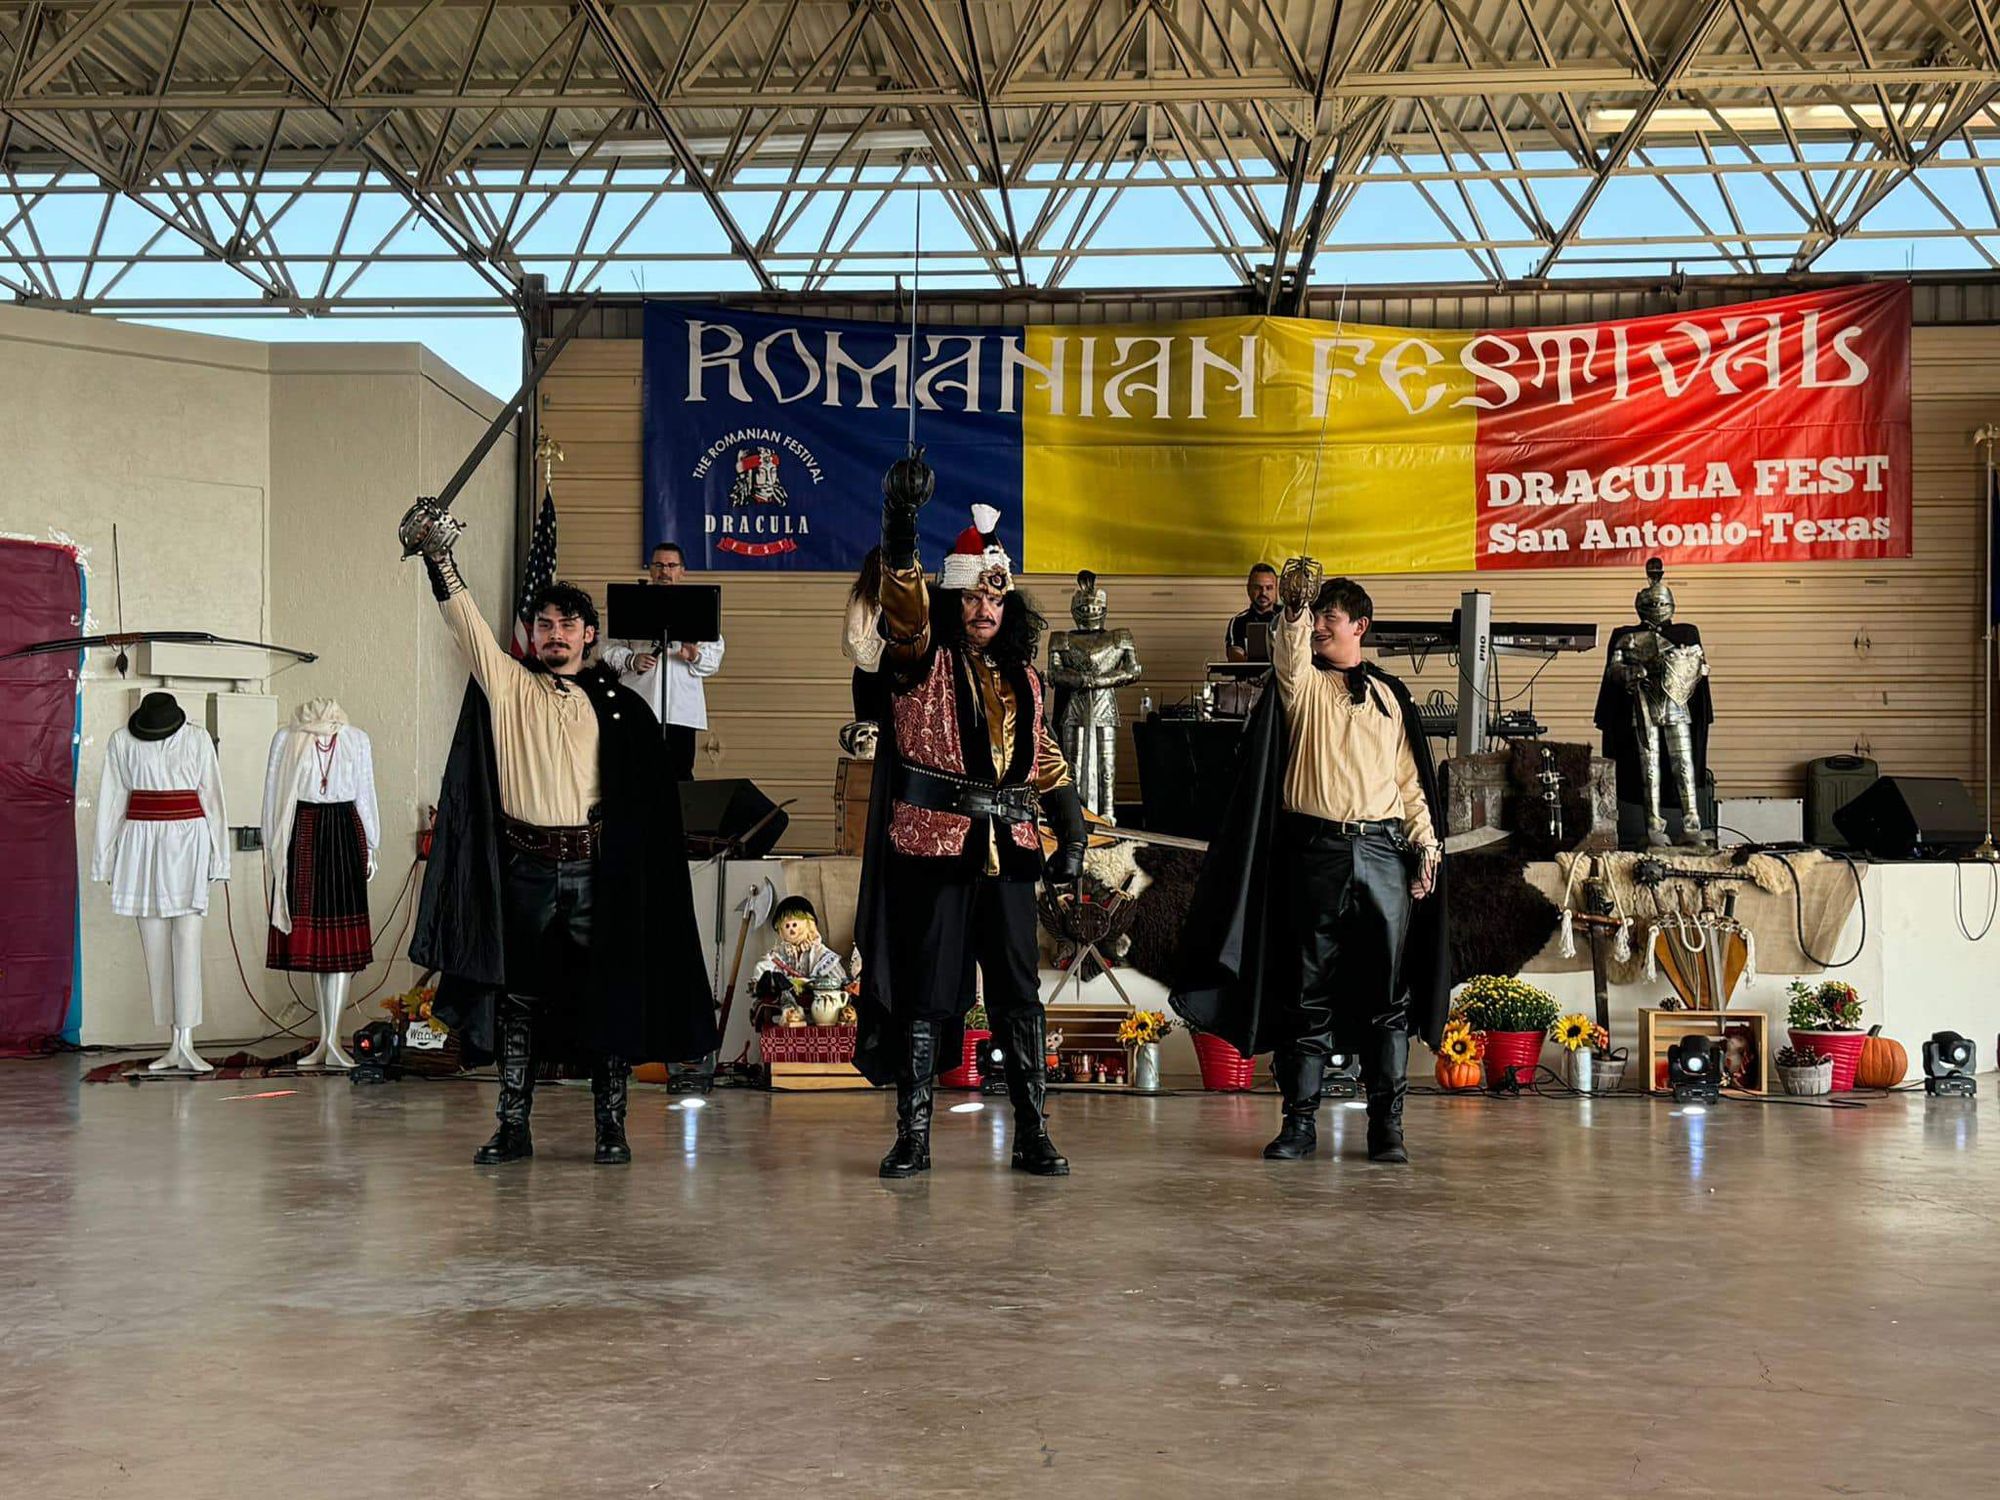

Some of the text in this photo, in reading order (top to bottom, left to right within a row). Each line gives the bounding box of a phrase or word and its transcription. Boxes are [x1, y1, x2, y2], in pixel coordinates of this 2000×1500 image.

[684, 319, 1258, 419] ROMANIAN
[692, 428, 824, 485] THE ROMANIAN FESTIVAL
[1486, 455, 1889, 507] DRACULA FEST
[704, 514, 809, 534] DRACULA
[1487, 512, 1890, 554] San Antonio-Texas
